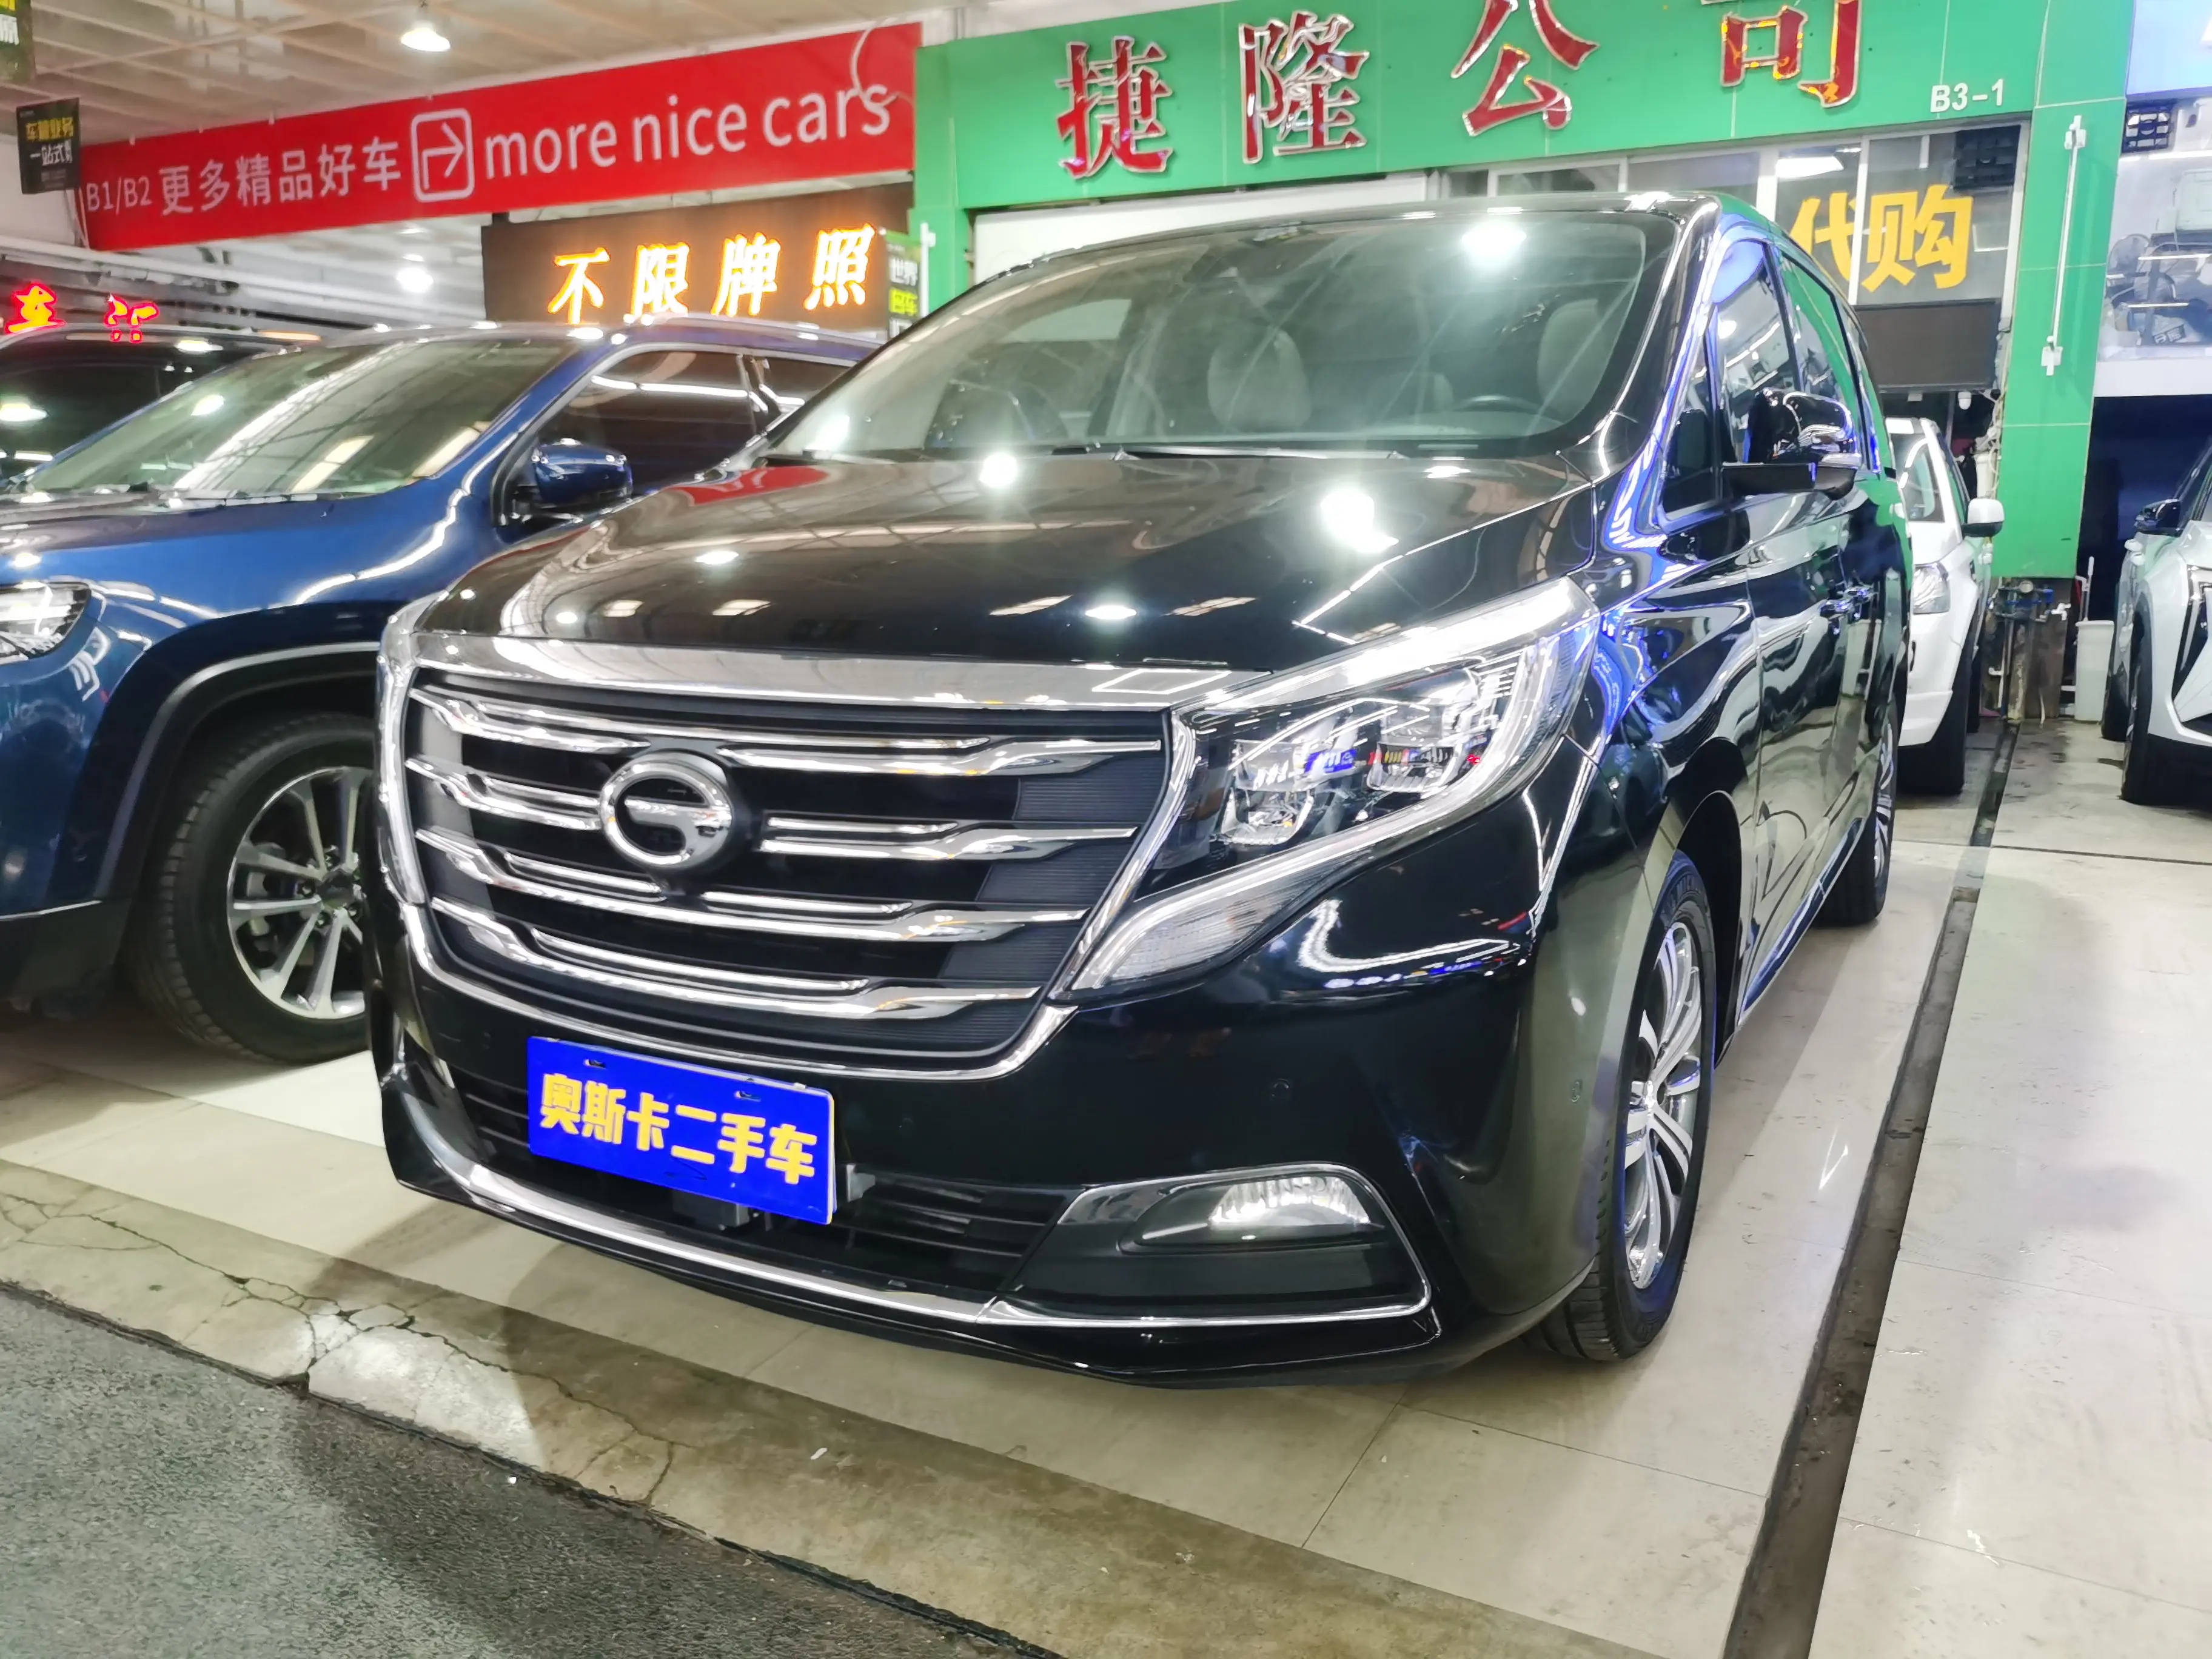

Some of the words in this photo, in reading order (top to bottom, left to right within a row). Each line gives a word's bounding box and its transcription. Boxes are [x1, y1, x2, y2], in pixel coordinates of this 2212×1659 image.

[485, 119, 617, 179] more
[632, 95, 748, 163] nice
[762, 83, 891, 147] cars
[1056, 0, 1862, 179] 捷隆公司
[1930, 78, 2004, 113] B3-1
[86, 176, 152, 215] B1/B2
[159, 136, 401, 216] 更多精品好车
[547, 223, 876, 324] 不限牌照
[1789, 184, 1973, 293] 代购
[540, 1073, 817, 1185] 奥斯卡二手车
